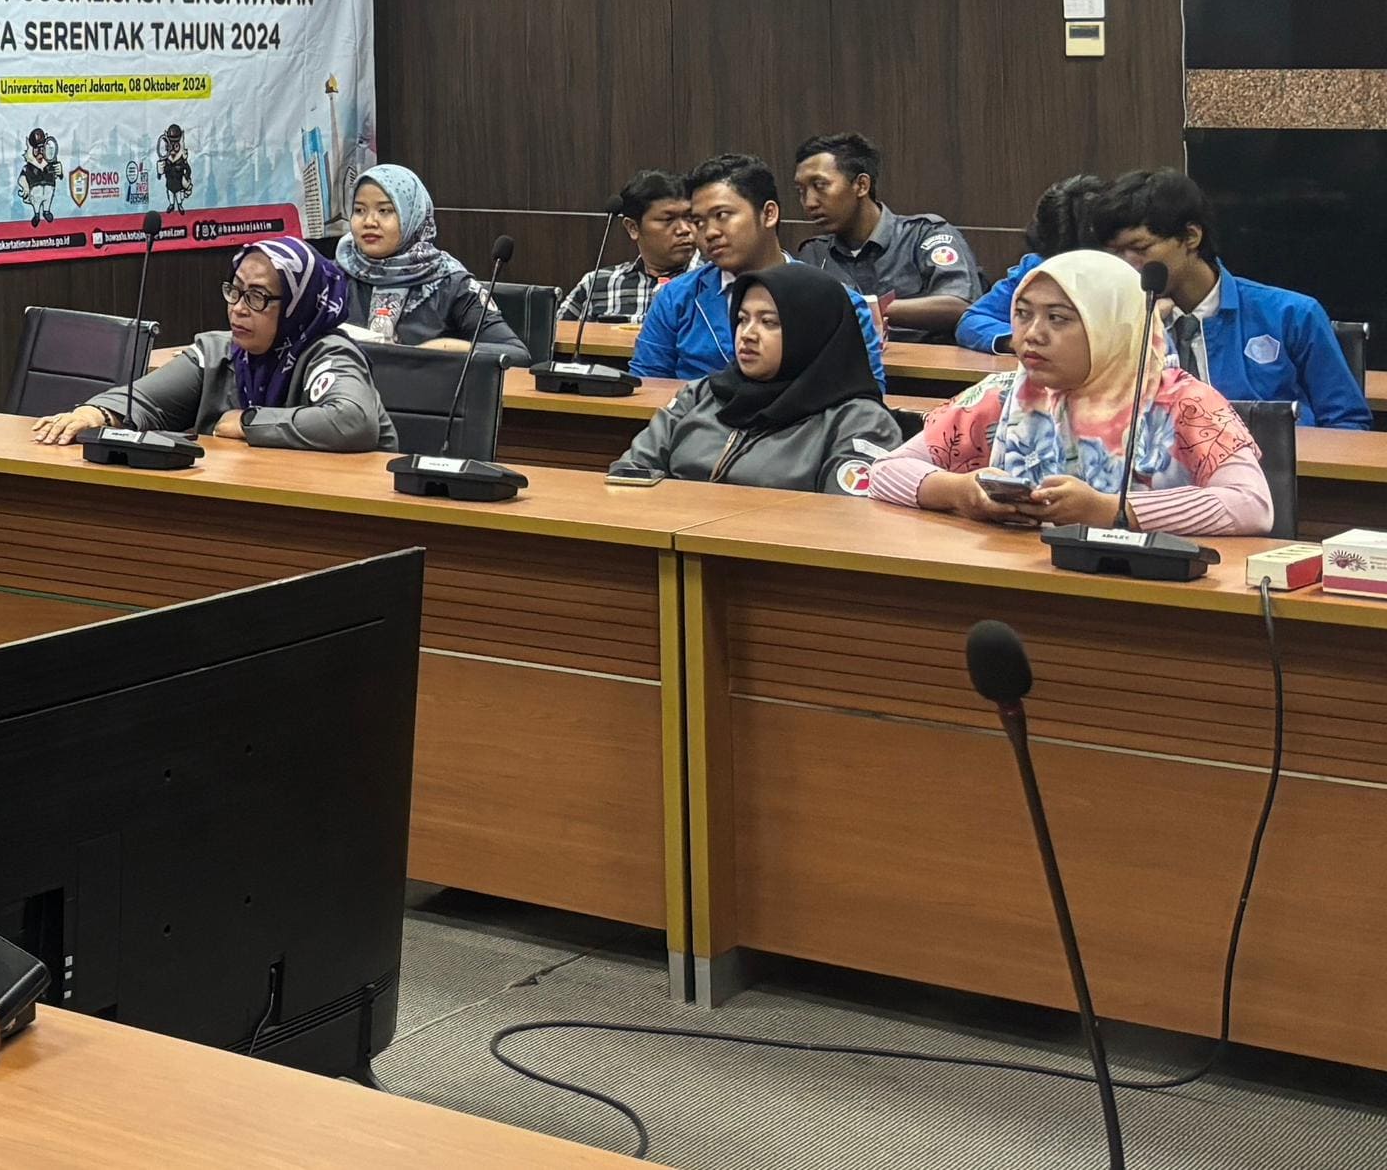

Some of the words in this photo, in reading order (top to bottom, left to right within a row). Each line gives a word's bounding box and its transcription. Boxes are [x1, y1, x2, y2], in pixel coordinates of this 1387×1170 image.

[24, 20, 144, 51] SERENTAK
[150, 22, 225, 50] TAHUN
[231, 23, 281, 50] 2024
[0, 79, 54, 95] Universitas
[56, 79, 87, 97] Negeri
[89, 79, 127, 95] Jakarta,
[129, 78, 141, 92] 08
[143, 77, 180, 92] Oktober
[182, 77, 206, 91] 2024
[90, 172, 119, 185] POSKO
